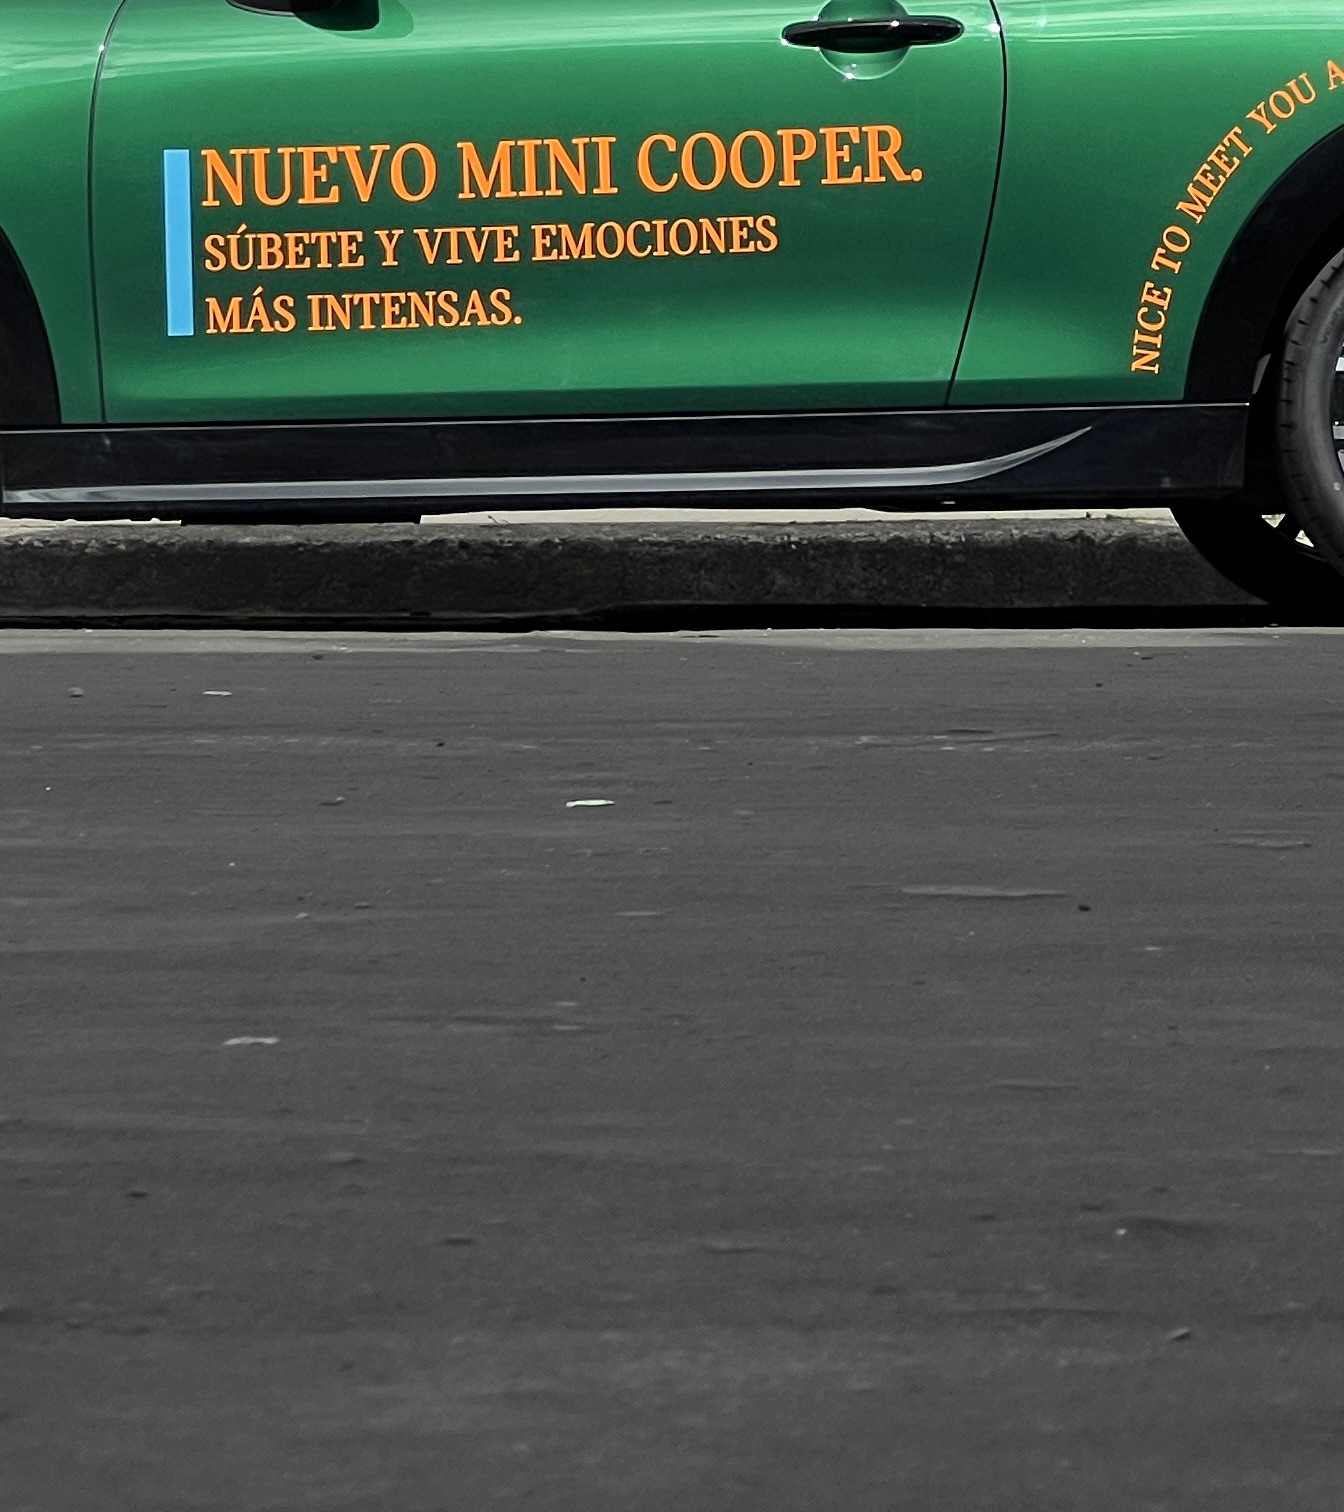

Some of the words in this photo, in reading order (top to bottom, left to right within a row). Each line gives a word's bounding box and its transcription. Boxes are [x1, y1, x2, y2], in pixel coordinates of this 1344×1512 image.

[1246, 73, 1317, 134] YOU
[202, 142, 437, 207] NUEVO
[457, 136, 618, 200] MINI
[637, 124, 923, 193] COOPER.
[1176, 126, 1253, 224] MEET
[204, 224, 365, 272] SÚBETE
[375, 229, 403, 267] Y
[414, 224, 521, 265] VIVE
[532, 214, 778, 262] EMOCIONES
[1151, 224, 1191, 274] TO
[206, 285, 296, 334] MÁS
[308, 288, 523, 331] INTENSAS.
[1131, 281, 1173, 375] NICE
